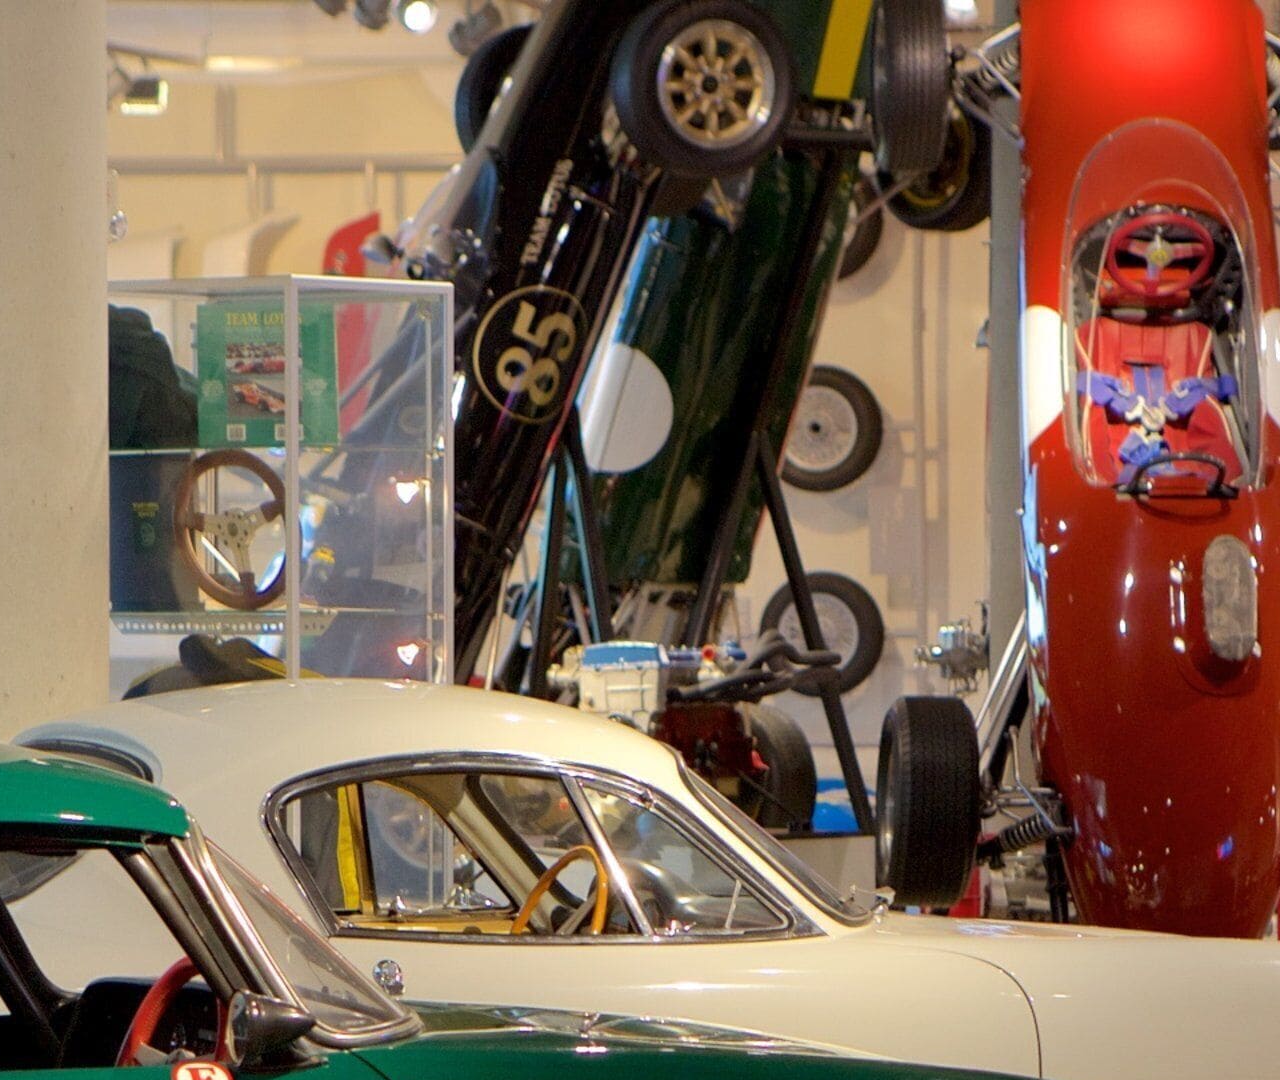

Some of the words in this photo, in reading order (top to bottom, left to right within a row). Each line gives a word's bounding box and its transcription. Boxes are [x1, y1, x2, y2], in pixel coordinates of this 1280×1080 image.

[521, 216, 552, 264] TEAM
[224, 312, 257, 327] TEAM
[496, 301, 577, 406] 85
